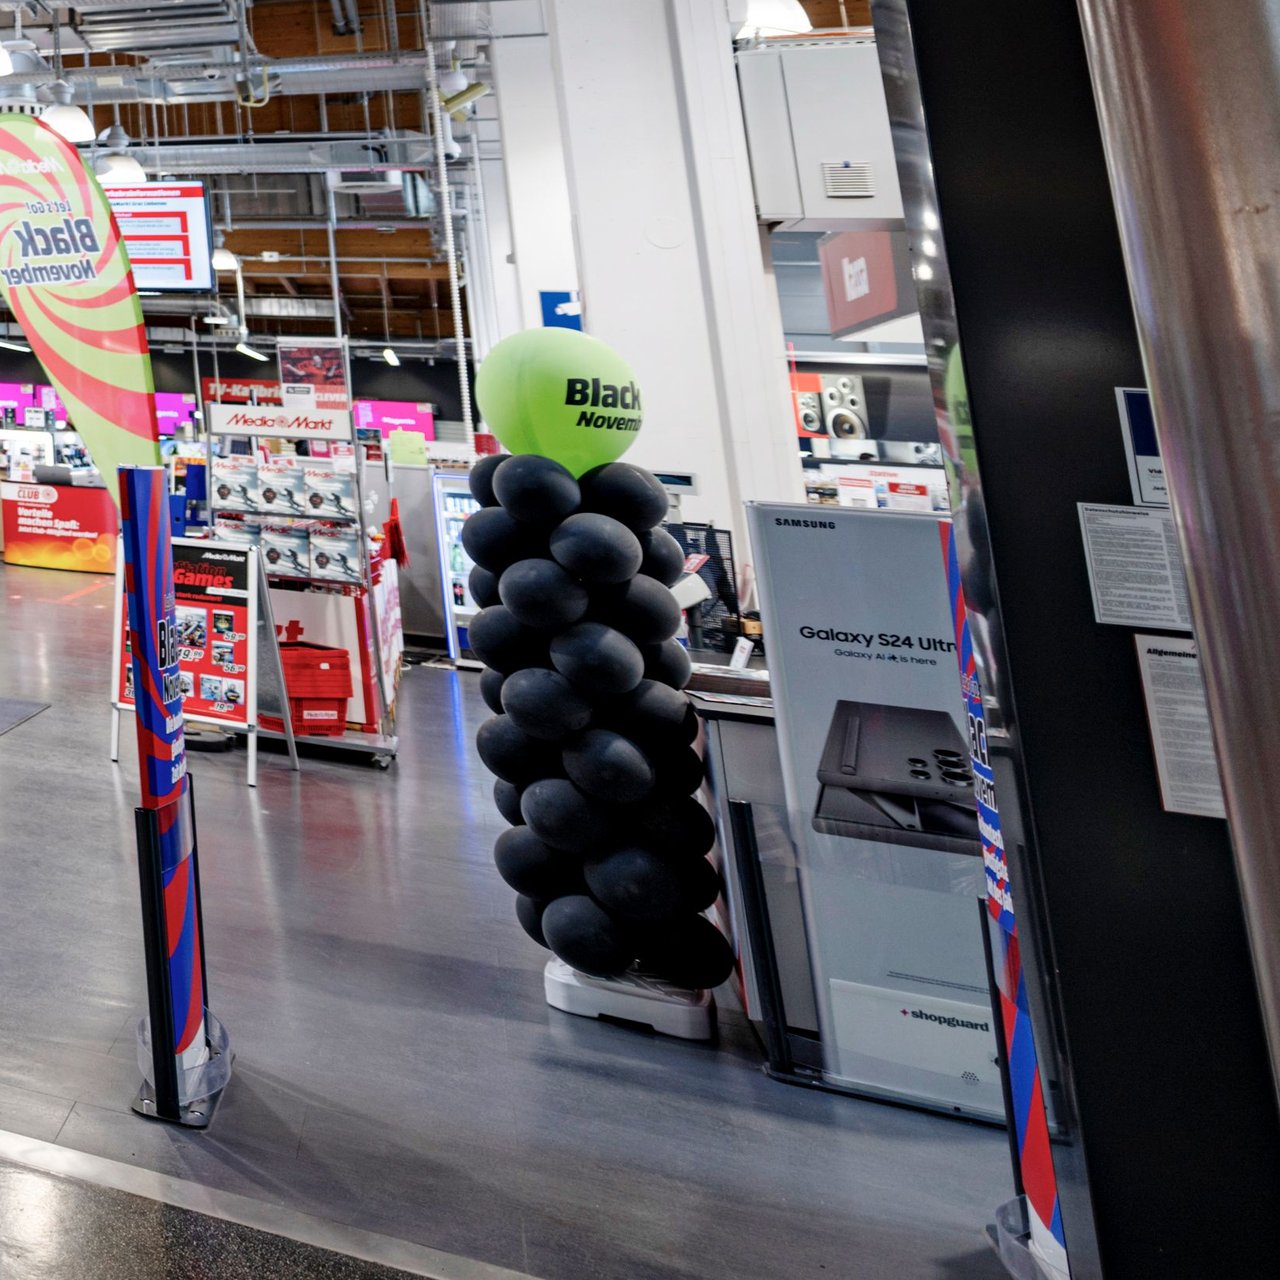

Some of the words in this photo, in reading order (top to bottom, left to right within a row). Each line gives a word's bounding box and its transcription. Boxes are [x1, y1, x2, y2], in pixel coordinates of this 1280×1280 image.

[565, 378, 642, 411] Black
[227, 413, 277, 428] Media
[288, 417, 333, 431] Markt
[775, 517, 836, 530] SAMSUNG
[174, 568, 234, 589] Games
[799, 626, 874, 648] Galaxy
[878, 633, 914, 649] S24
[919, 637, 958, 653] Ultr
[834, 649, 873, 661] Galaxy
[900, 656, 909, 664] is
[910, 656, 937, 666] here
[911, 1009, 989, 1032] shopguard
